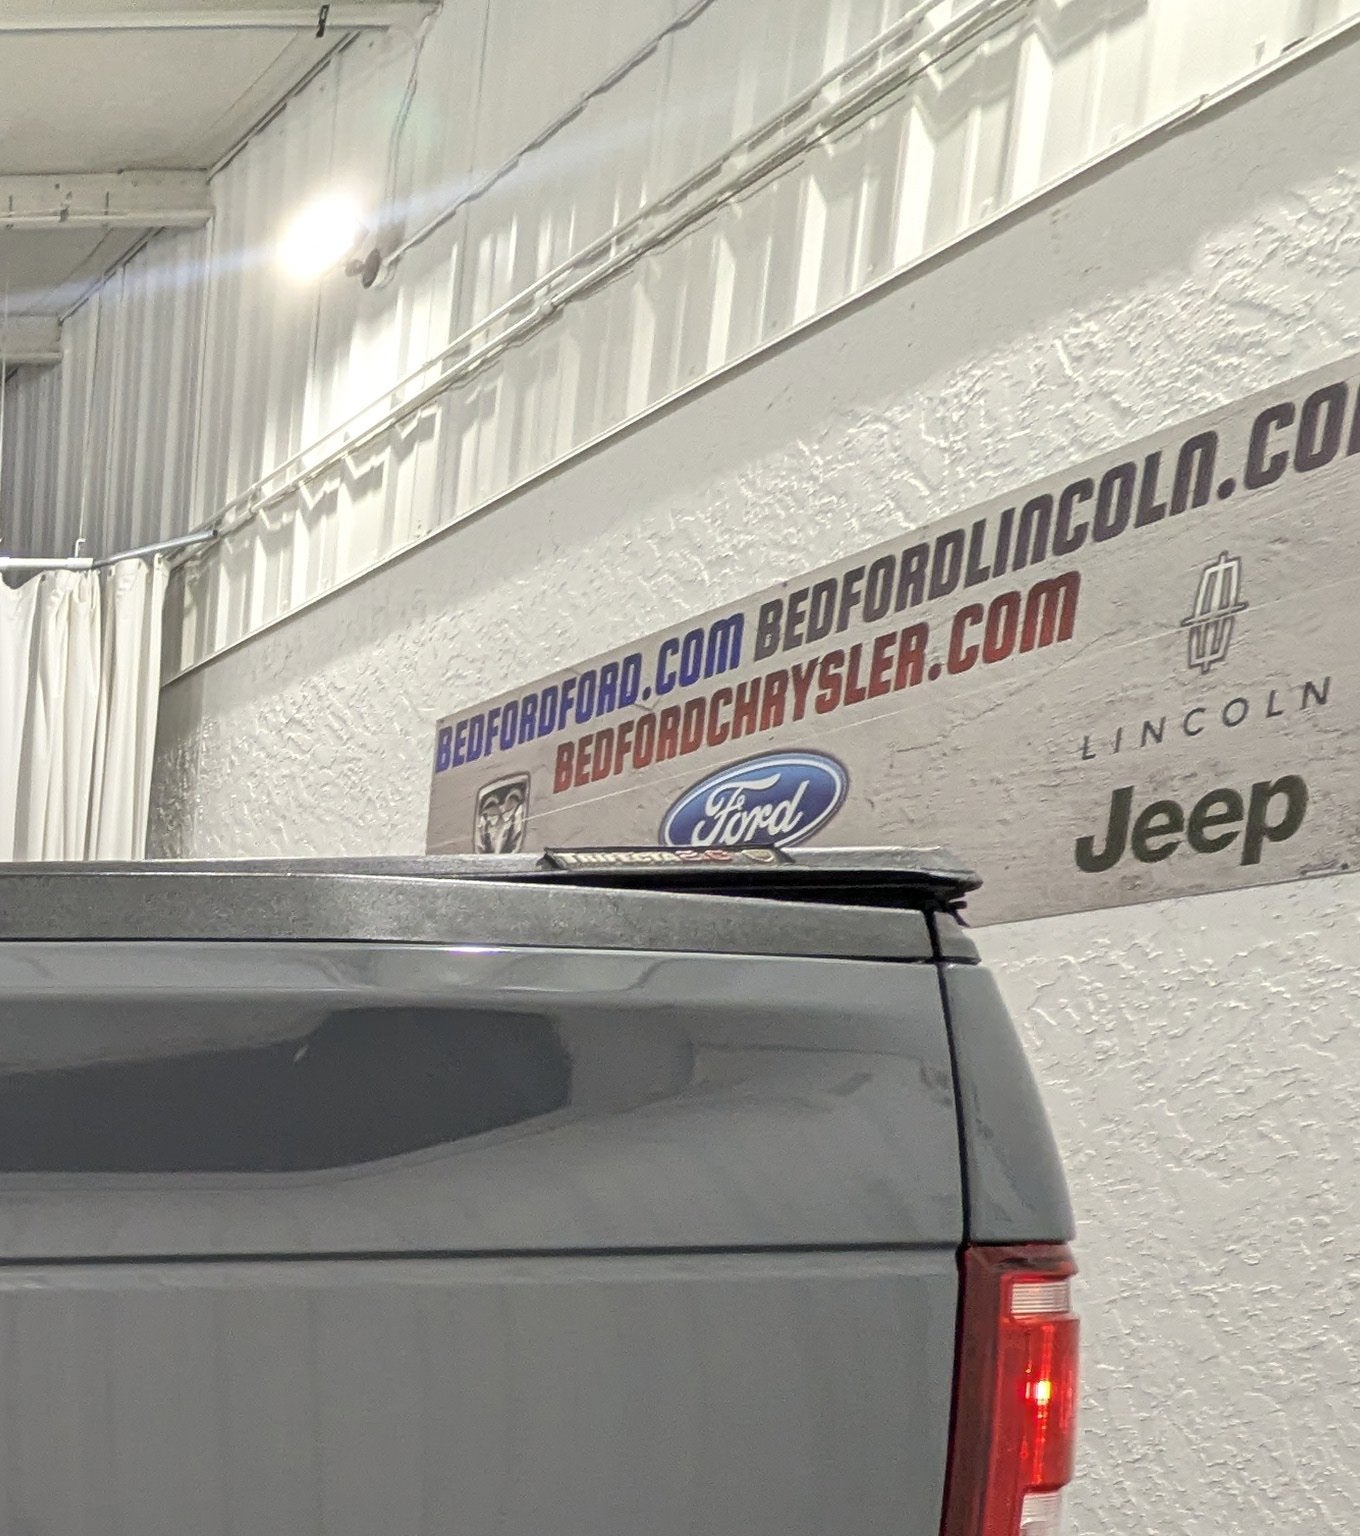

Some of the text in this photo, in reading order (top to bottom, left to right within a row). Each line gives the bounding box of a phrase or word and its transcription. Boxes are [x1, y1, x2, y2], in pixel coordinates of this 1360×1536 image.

[435, 380, 1360, 774] BEDFORDFORD.COM BEDFORDLINCOLN.CO
[553, 570, 1081, 794] BEDFORDCHRYSLER.COM
[1081, 676, 1331, 761] LINCOLN
[691, 772, 811, 846] Ford
[1074, 774, 1309, 873] Jeep
